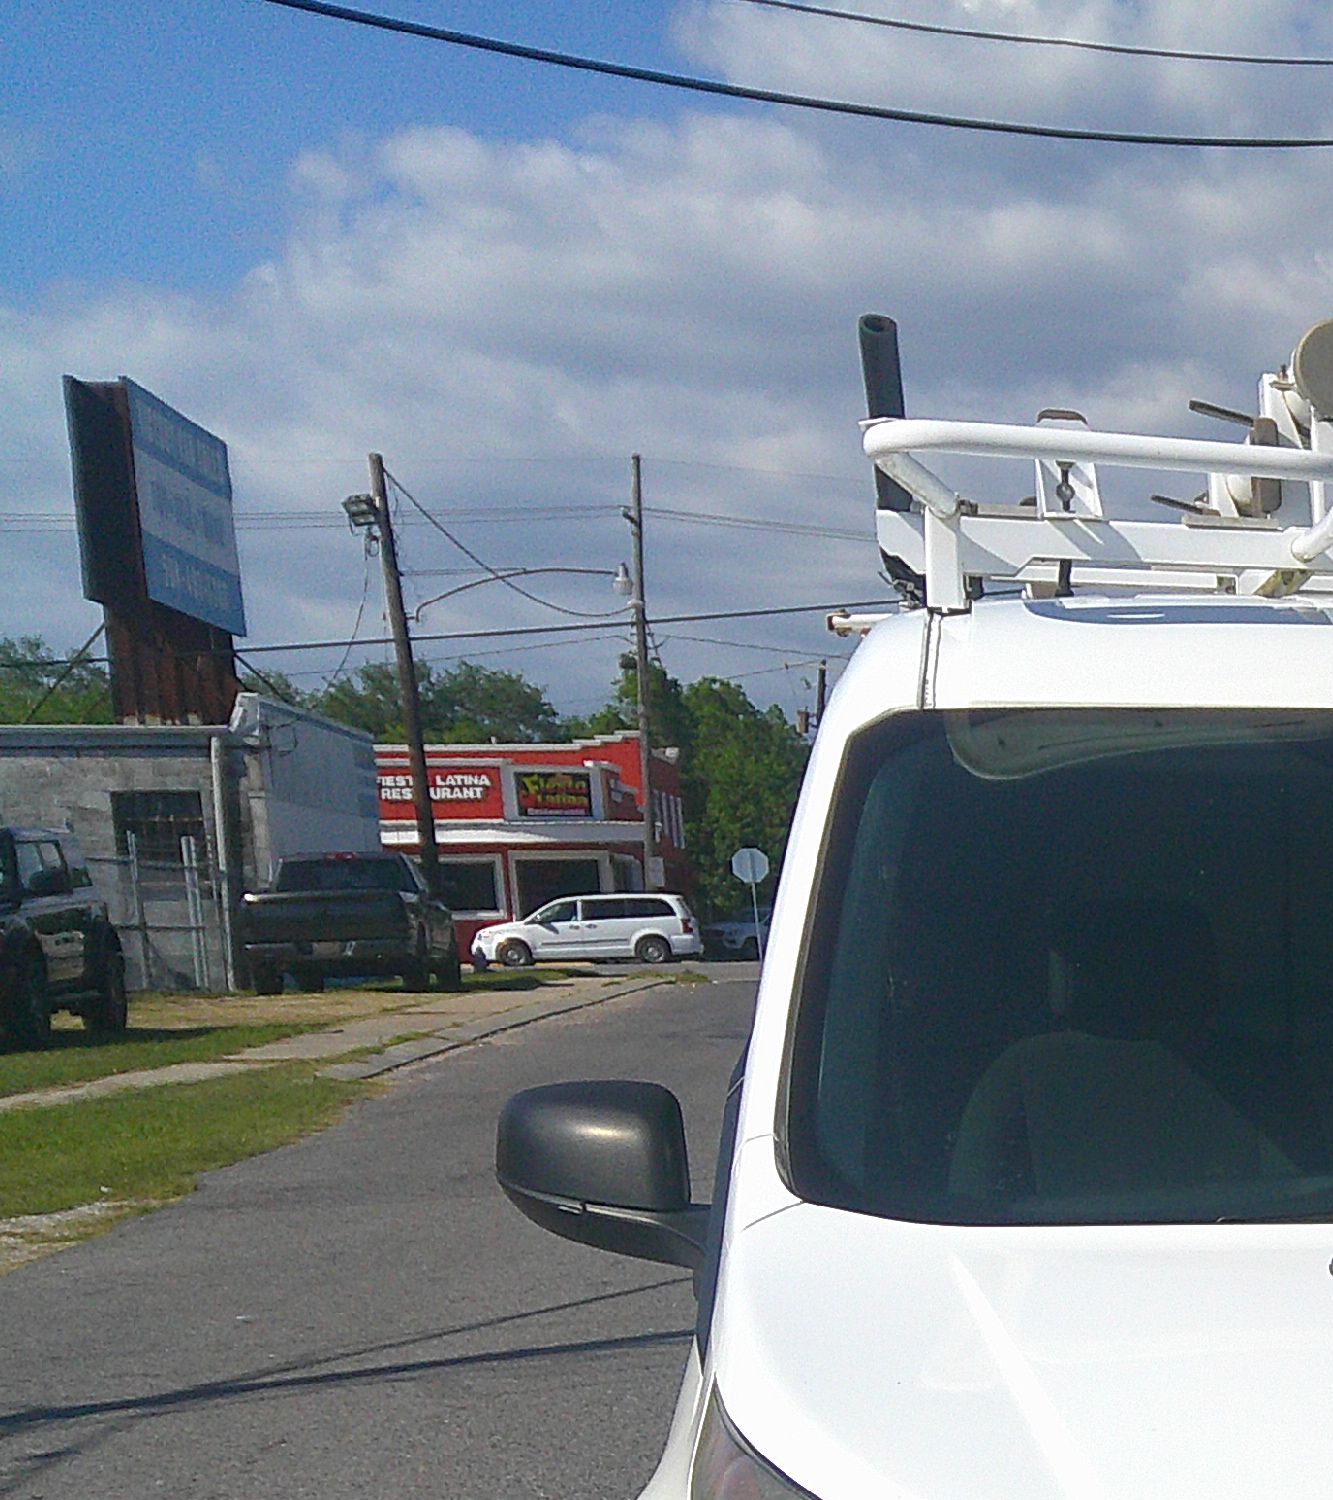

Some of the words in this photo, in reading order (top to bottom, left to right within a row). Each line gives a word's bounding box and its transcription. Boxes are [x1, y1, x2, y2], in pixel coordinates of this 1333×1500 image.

[376, 775, 415, 786] FIEST
[435, 774, 491, 786] LATINA
[381, 787, 483, 800] RESURANT
